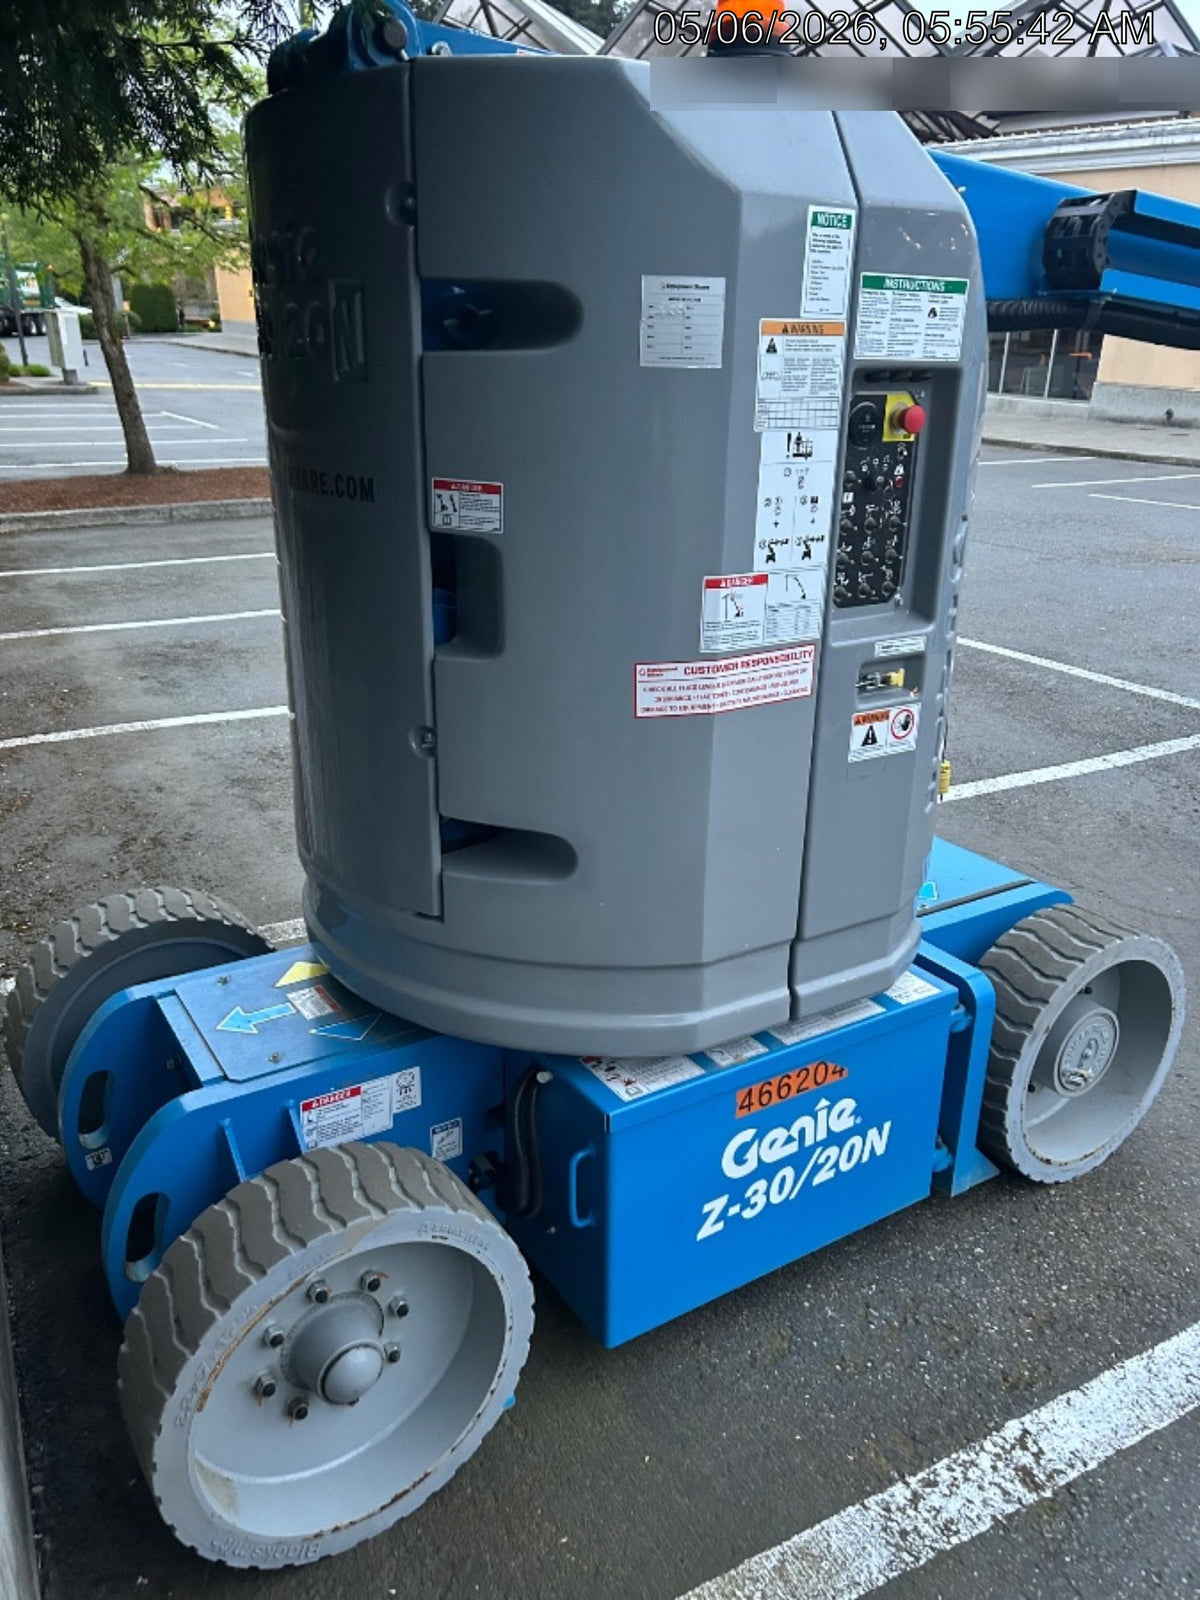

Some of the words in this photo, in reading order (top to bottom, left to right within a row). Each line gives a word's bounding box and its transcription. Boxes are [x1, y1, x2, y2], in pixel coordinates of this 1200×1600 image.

[816, 212, 848, 229] NOTICE
[883, 277, 945, 292] INSTRUCTIONS
[683, 662, 740, 676] CUSTOMER
[741, 649, 814, 671] RESPONSIBILITY
[738, 1060, 846, 1113] 466204
[721, 1098, 858, 1179] Genie
[696, 1120, 892, 1241] Z-30/20N
